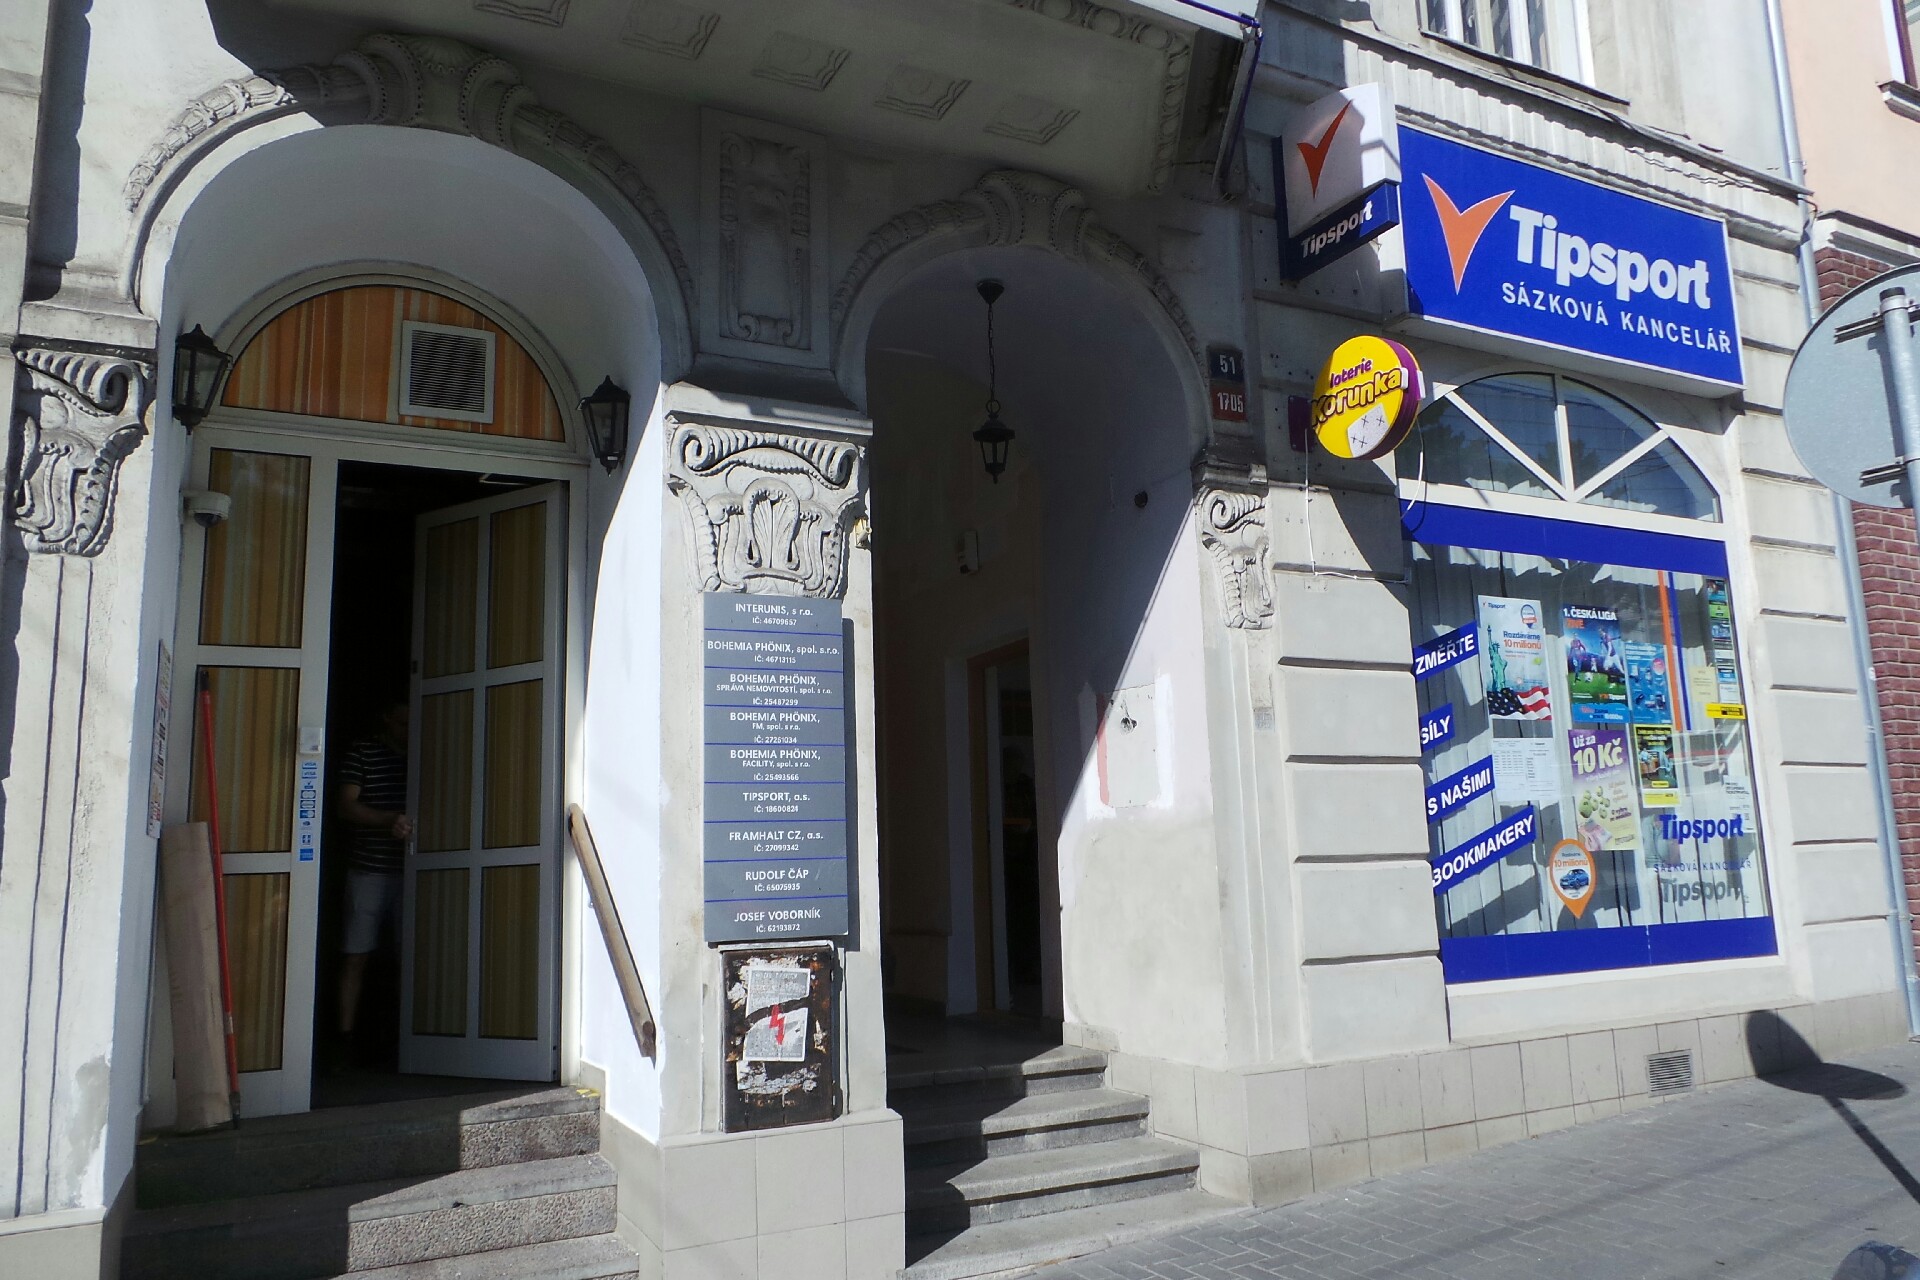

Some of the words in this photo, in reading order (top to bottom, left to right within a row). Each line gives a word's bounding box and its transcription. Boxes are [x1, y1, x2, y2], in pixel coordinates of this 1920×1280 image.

[1301, 200, 1373, 258] Tipsport
[1510, 204, 1710, 310] Tipsport
[1502, 281, 1609, 326] SÁZKOVÁ
[1620, 310, 1732, 354] KANCELÁŘ
[1219, 354, 1236, 374] 51
[1329, 357, 1373, 388] loterie
[1217, 392, 1244, 413] 1705
[735, 603, 789, 615] INTERUNIS,
[799, 608, 813, 616] r.o.
[1563, 608, 1570, 617] 1.
[1570, 606, 1597, 619] ČESKÁ
[1597, 610, 1618, 621] LIGA
[763, 618, 797, 626] 46709657
[707, 640, 753, 651] BOHEMIA
[755, 641, 794, 653] PHÖNIX,
[796, 645, 817, 655] spol.
[819, 647, 840, 655] s.r.o.
[1504, 639, 1512, 648] 10
[754, 655, 764, 663] IČ:
[765, 656, 796, 664] 46713115
[1415, 633, 1475, 676] ZMĚŘTE
[730, 674, 776, 684] BOHEMIA
[779, 674, 820, 686] PHÖNIX,
[716, 684, 744, 692] SPRÁVA
[799, 687, 815, 695] spol.
[753, 697, 762, 705] IČ:
[764, 698, 798, 706] 25487299
[730, 712, 776, 721] BOHEMIA
[779, 712, 820, 723] PHÖNIX,
[752, 723, 765, 731] FM,
[766, 723, 783, 732] spol.
[1420, 714, 1452, 745] SÍLY
[754, 736, 764, 744] IČ:
[1572, 734, 1584, 749] Už
[1585, 734, 1596, 745] za
[730, 750, 777, 759] BOHEMIA
[780, 749, 821, 761] PHÖNIX,
[1573, 747, 1596, 775] 10
[1597, 737, 1624, 770] Kč
[743, 760, 775, 768] FACILITY,
[777, 760, 793, 769] spol.
[754, 773, 763, 781] IČ:
[743, 792, 792, 803] TIPSPORT,
[1427, 796, 1439, 816] S
[1440, 767, 1491, 810] NAŠIMI
[754, 805, 764, 813] IČ:
[1659, 814, 1744, 845] Tipsport
[729, 831, 784, 841] FRAMHALT
[787, 831, 804, 840] CZ,
[807, 832, 823, 840] a.s.
[754, 844, 764, 852] IČ:
[1432, 814, 1535, 888] BOOKMAKERY
[745, 870, 785, 881] RUDOLF
[788, 868, 809, 879] ČÁP
[754, 884, 765, 892] IČ:
[734, 911, 765, 922] JOSEF
[768, 907, 821, 920] VOBORNÍK
[756, 925, 766, 933] IČ:
